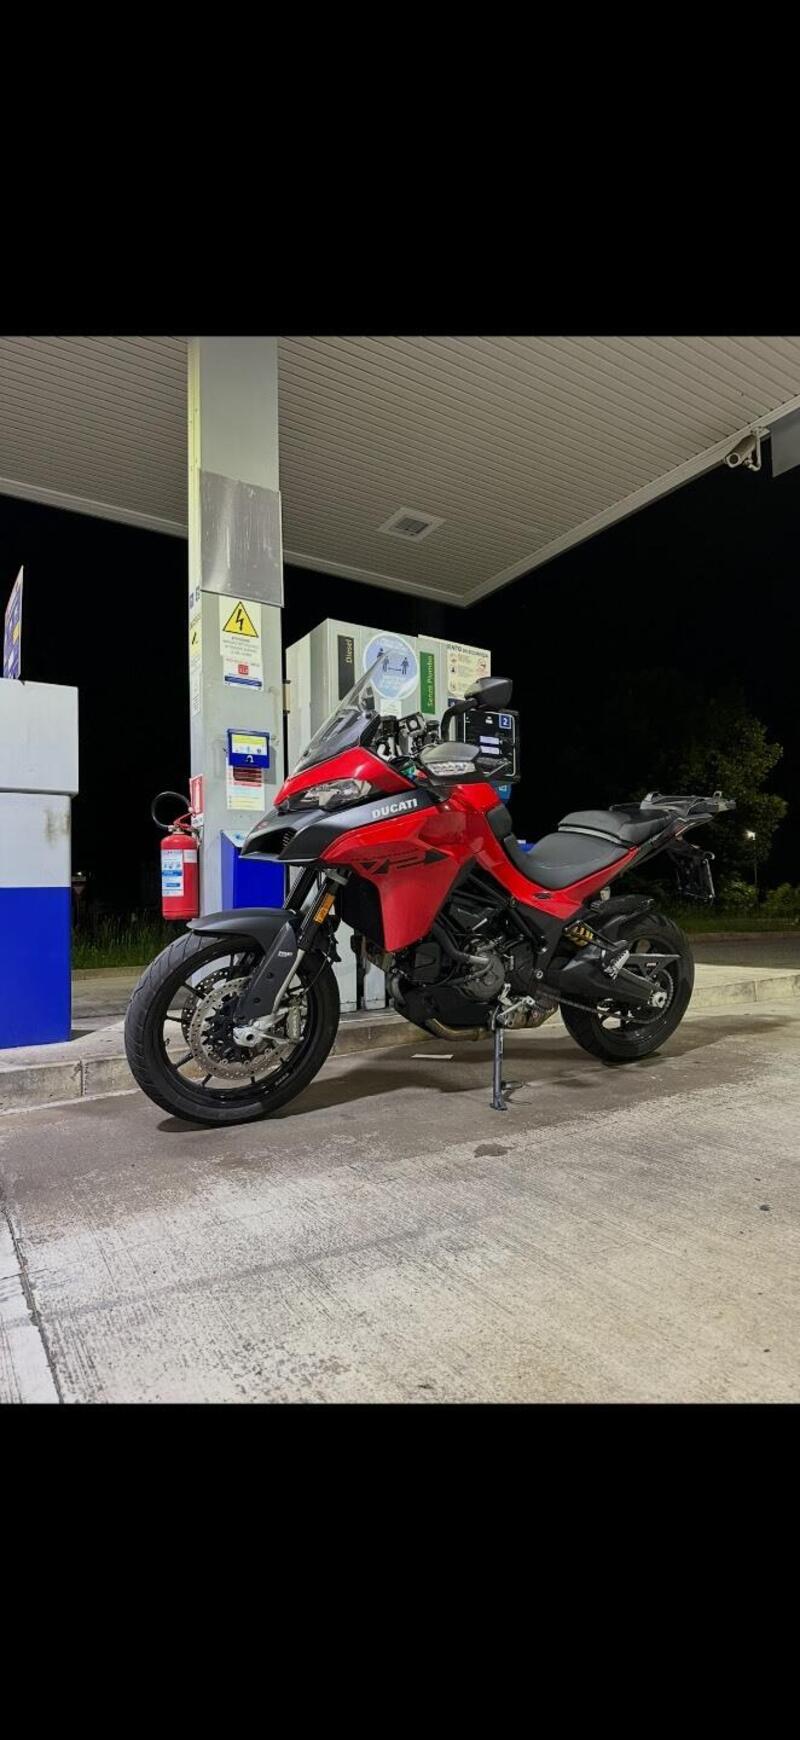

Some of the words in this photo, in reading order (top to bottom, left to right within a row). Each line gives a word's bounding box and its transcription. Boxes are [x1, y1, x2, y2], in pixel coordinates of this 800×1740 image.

[344, 638, 353, 664] Diesel
[502, 717, 508, 726] 2
[371, 798, 418, 819] DUCATI
